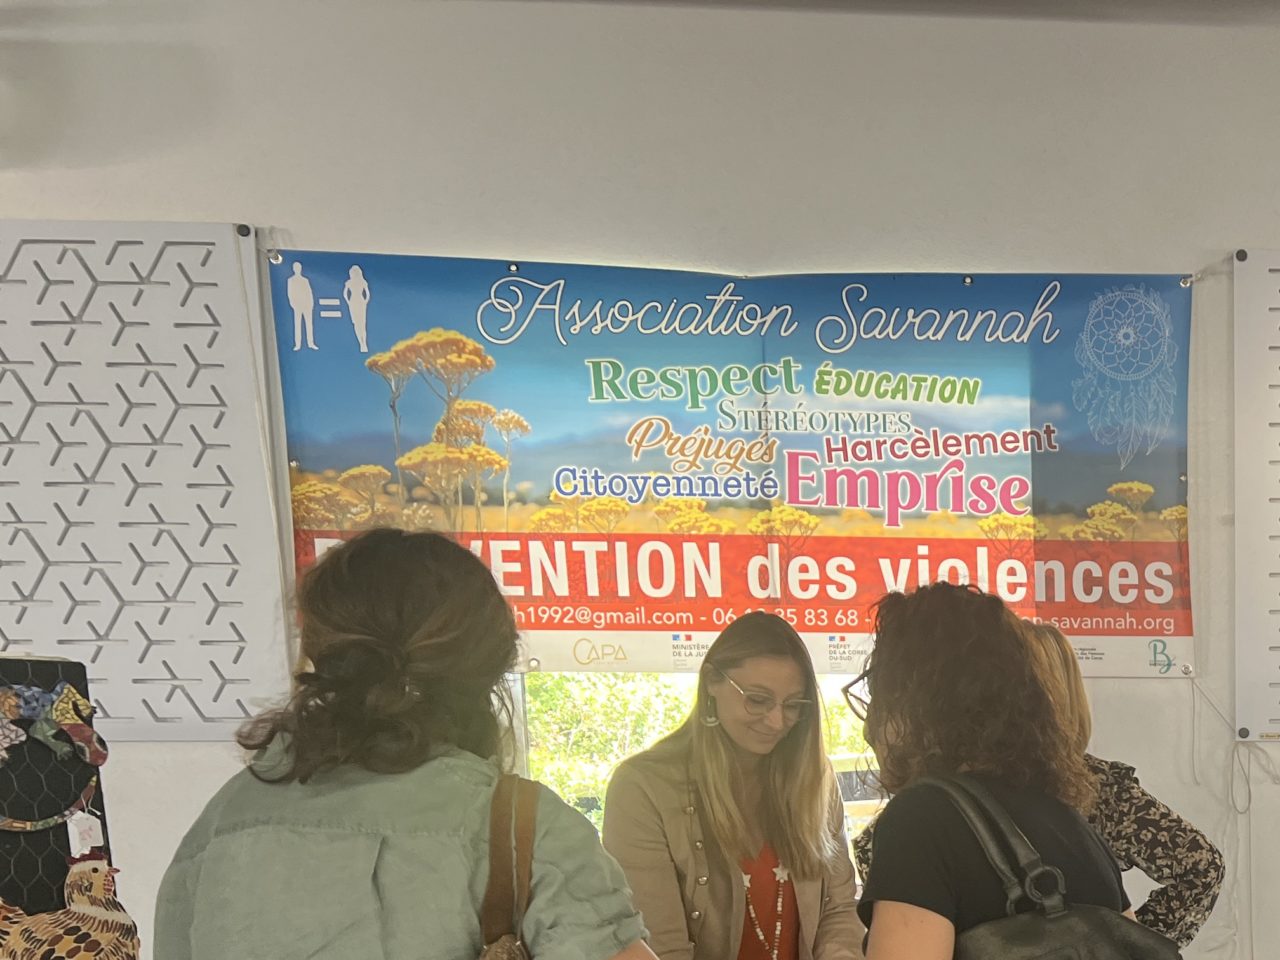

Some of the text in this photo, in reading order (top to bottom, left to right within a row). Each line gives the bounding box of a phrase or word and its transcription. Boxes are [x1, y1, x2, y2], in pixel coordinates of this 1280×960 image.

[476, 277, 1062, 354] Association Savannah
[586, 357, 982, 410] Respect ÉDUCATION
[627, 417, 778, 476] Préjugés
[825, 423, 1059, 465] Harcèlement
[554, 467, 779, 503] Citoyenneté
[785, 449, 1031, 528] Emprise
[314, 538, 1175, 605] ENTION des violences
[712, 607, 737, 625] 06
[804, 608, 828, 626] 83
[834, 609, 859, 626] 68
